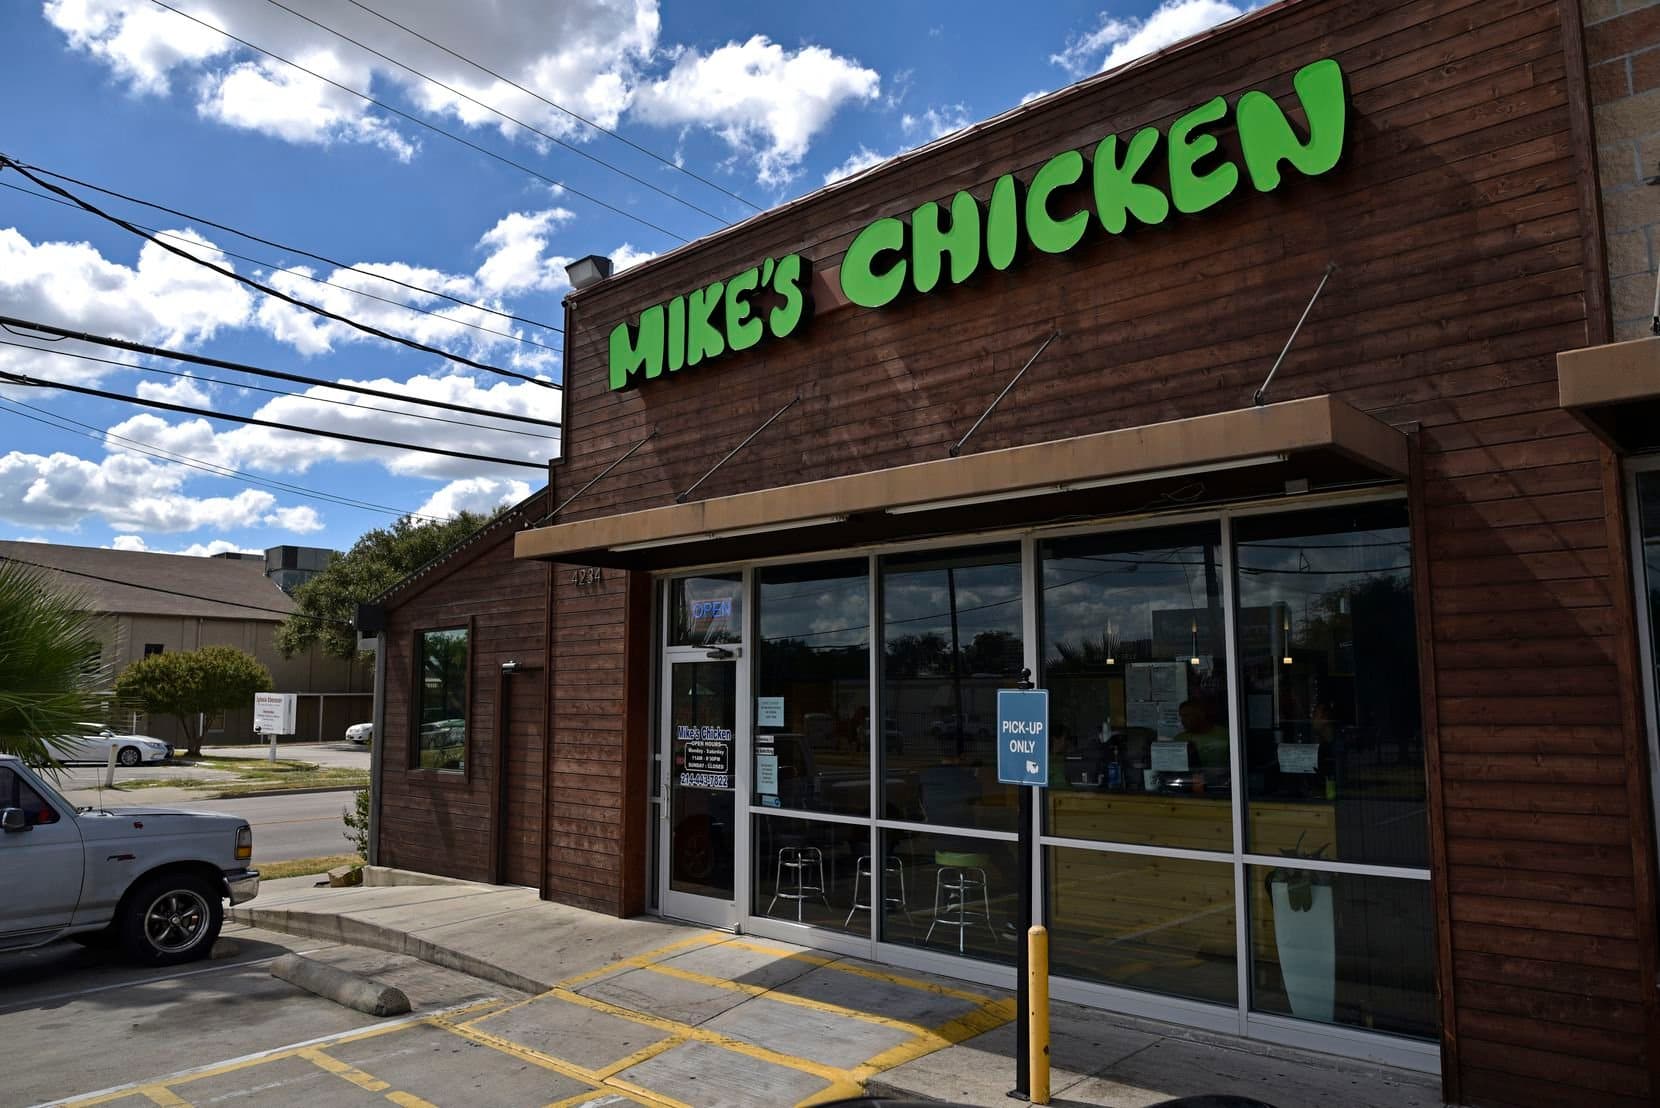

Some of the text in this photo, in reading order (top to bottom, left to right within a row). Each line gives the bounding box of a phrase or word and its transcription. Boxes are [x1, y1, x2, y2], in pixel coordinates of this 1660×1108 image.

[609, 58, 1346, 391] MIKE'S CHICKEN
[693, 599, 732, 618] OPEN
[678, 726, 732, 741] Mike's Chicken
[1002, 720, 1043, 735] PICK-UP
[1009, 739, 1036, 753] ONLY
